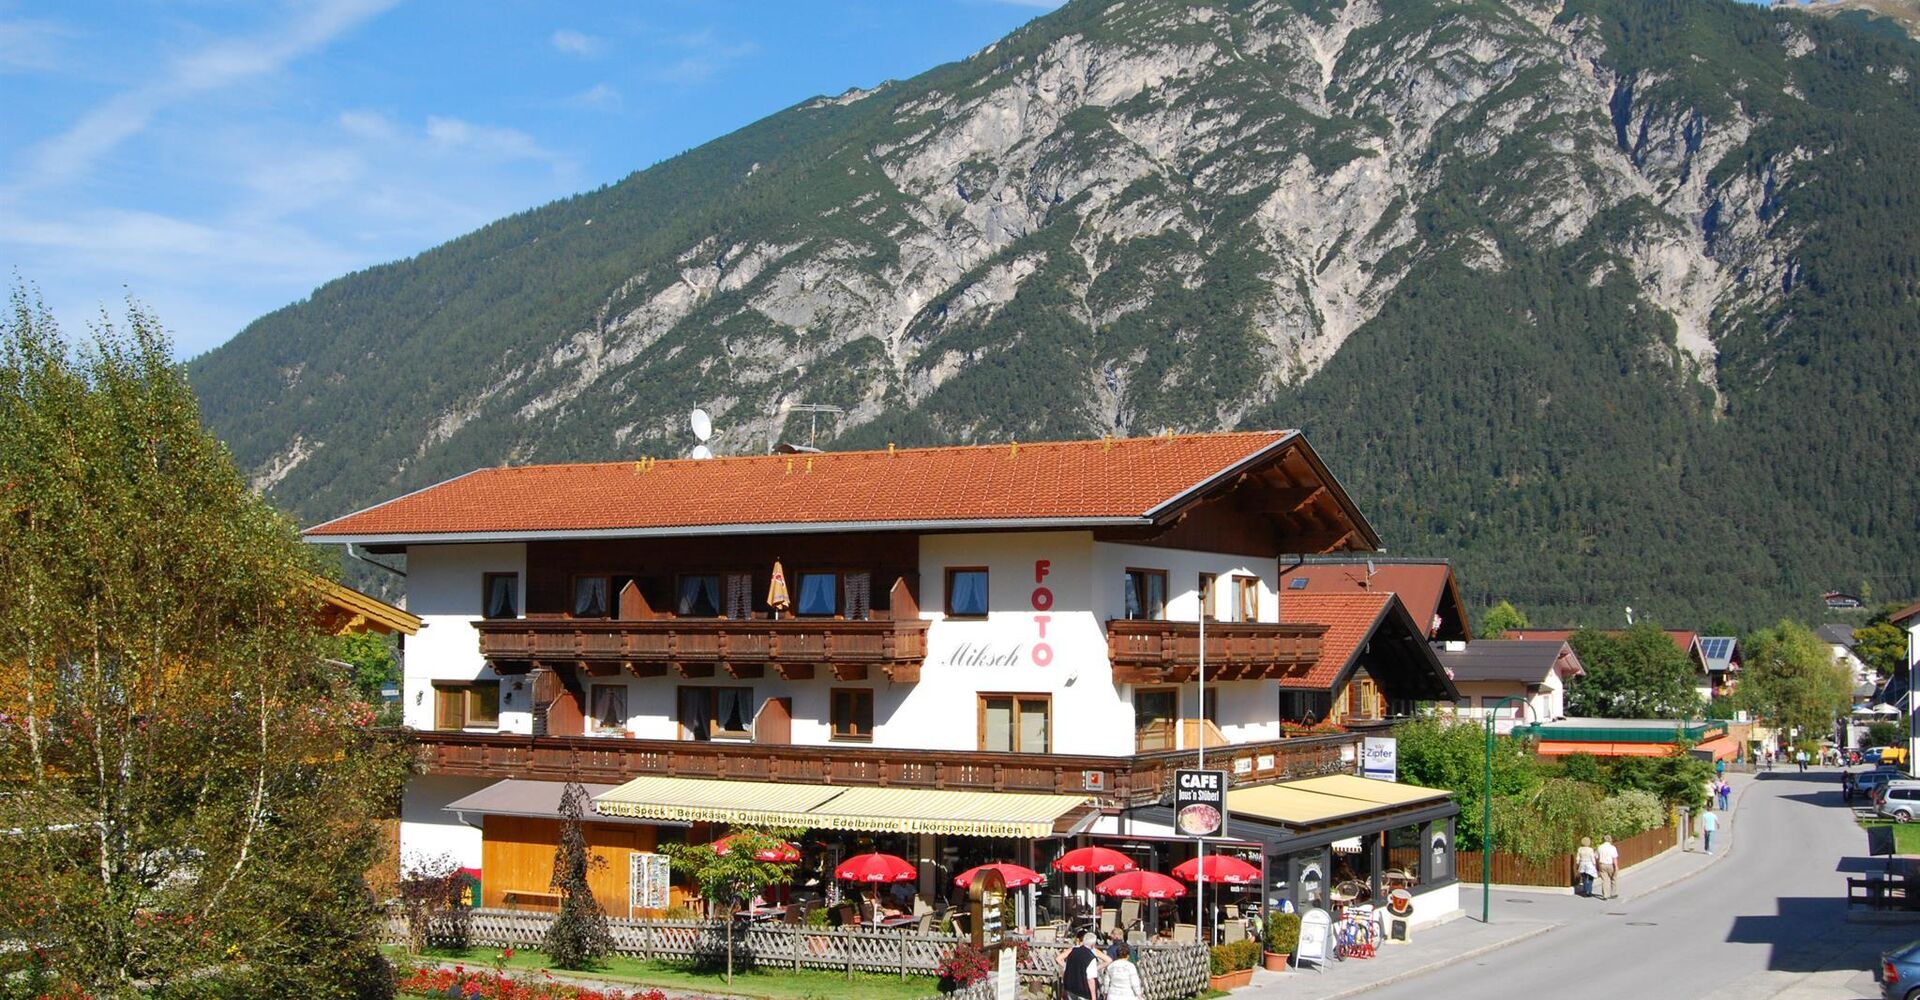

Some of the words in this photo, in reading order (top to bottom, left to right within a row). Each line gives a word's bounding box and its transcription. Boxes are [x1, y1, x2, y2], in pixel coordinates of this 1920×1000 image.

[1031, 560, 1053, 667] FOTO
[941, 642, 1023, 667] Miksch
[1366, 748, 1393, 759] Zipfer
[1180, 773, 1218, 789] CAFE
[634, 805, 666, 816] Speck
[676, 809, 727, 820] Bergkäse
[738, 812, 821, 826] Qualitätsweine
[832, 817, 899, 830] Edelbrände
[911, 821, 1022, 835] Likörspezialitäten
